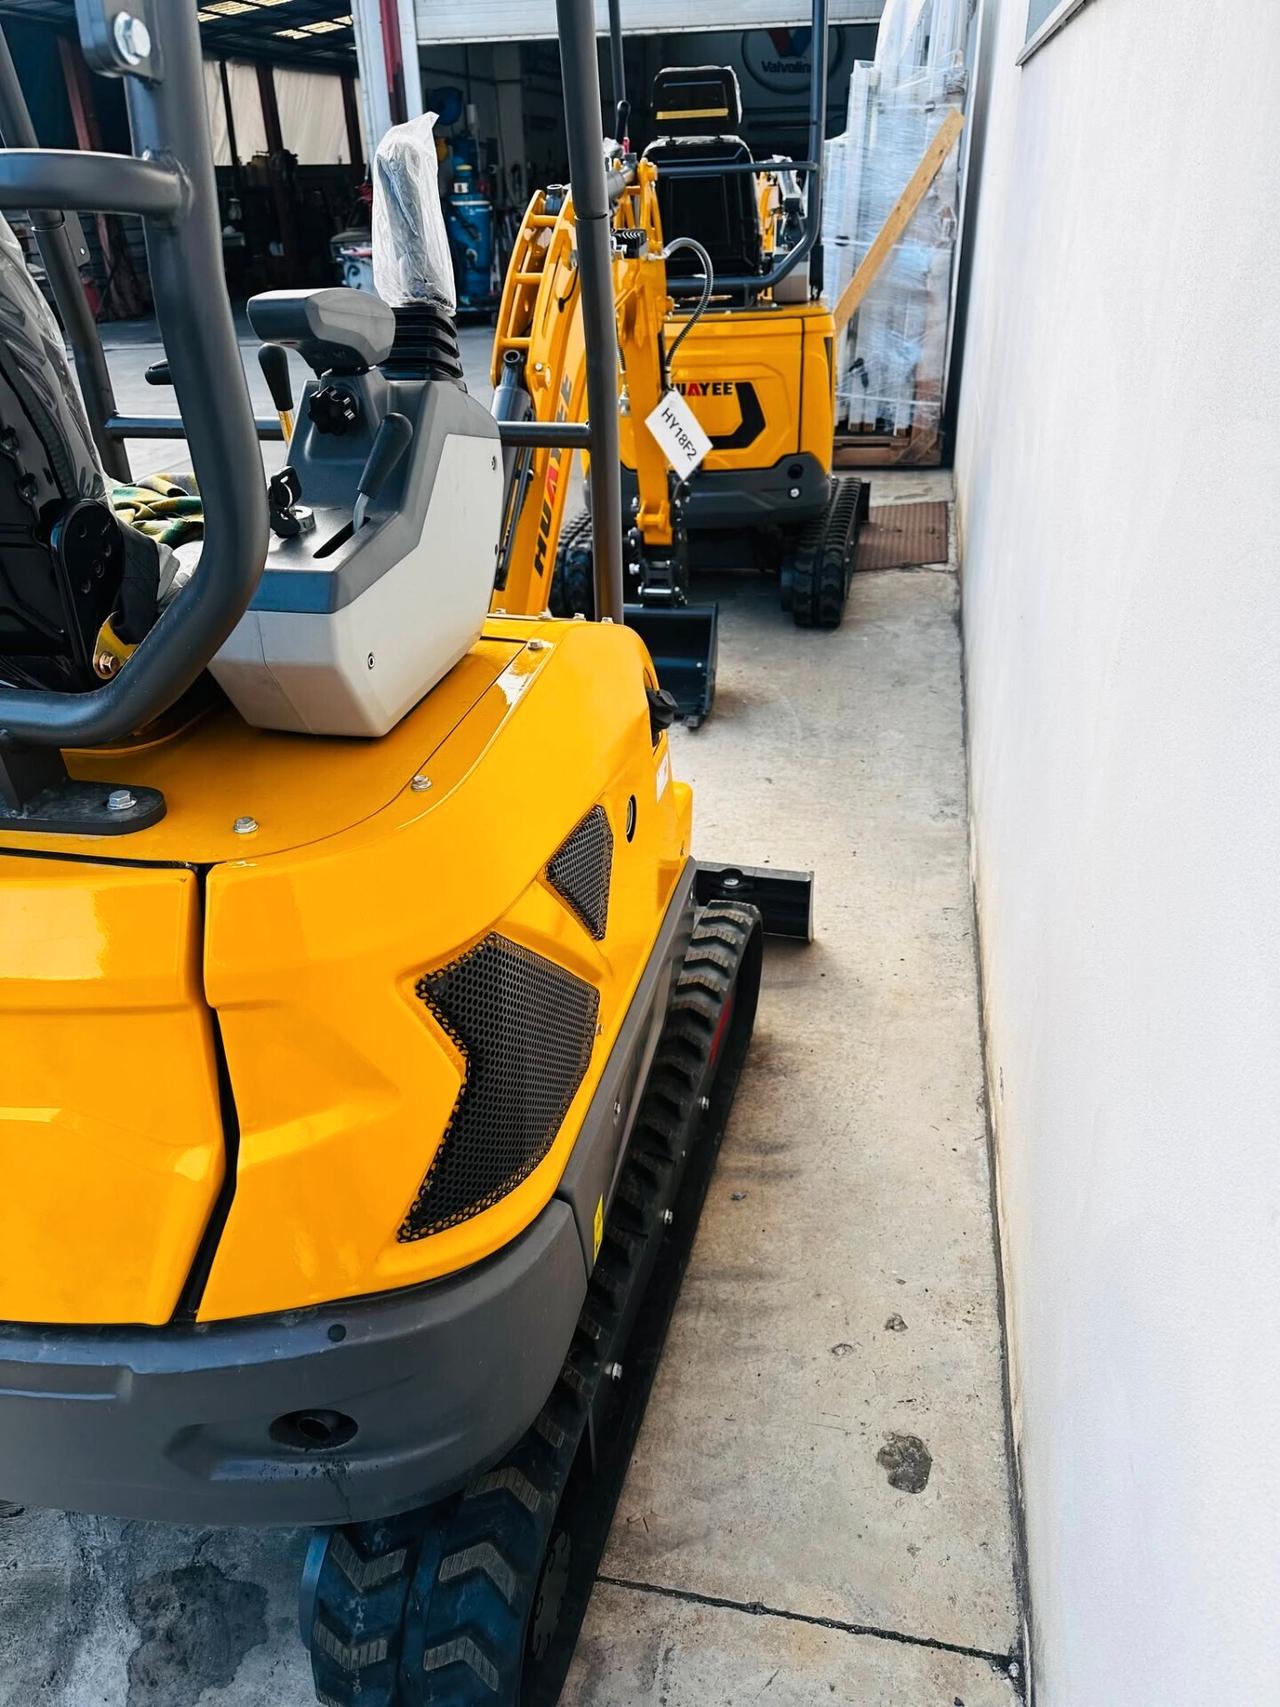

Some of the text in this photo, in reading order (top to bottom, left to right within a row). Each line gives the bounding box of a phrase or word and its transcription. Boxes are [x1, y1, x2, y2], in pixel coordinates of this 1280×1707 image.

[761, 61, 812, 73] Valvolin
[671, 382, 733, 396] UAYEE
[661, 407, 697, 461] HY18F2
